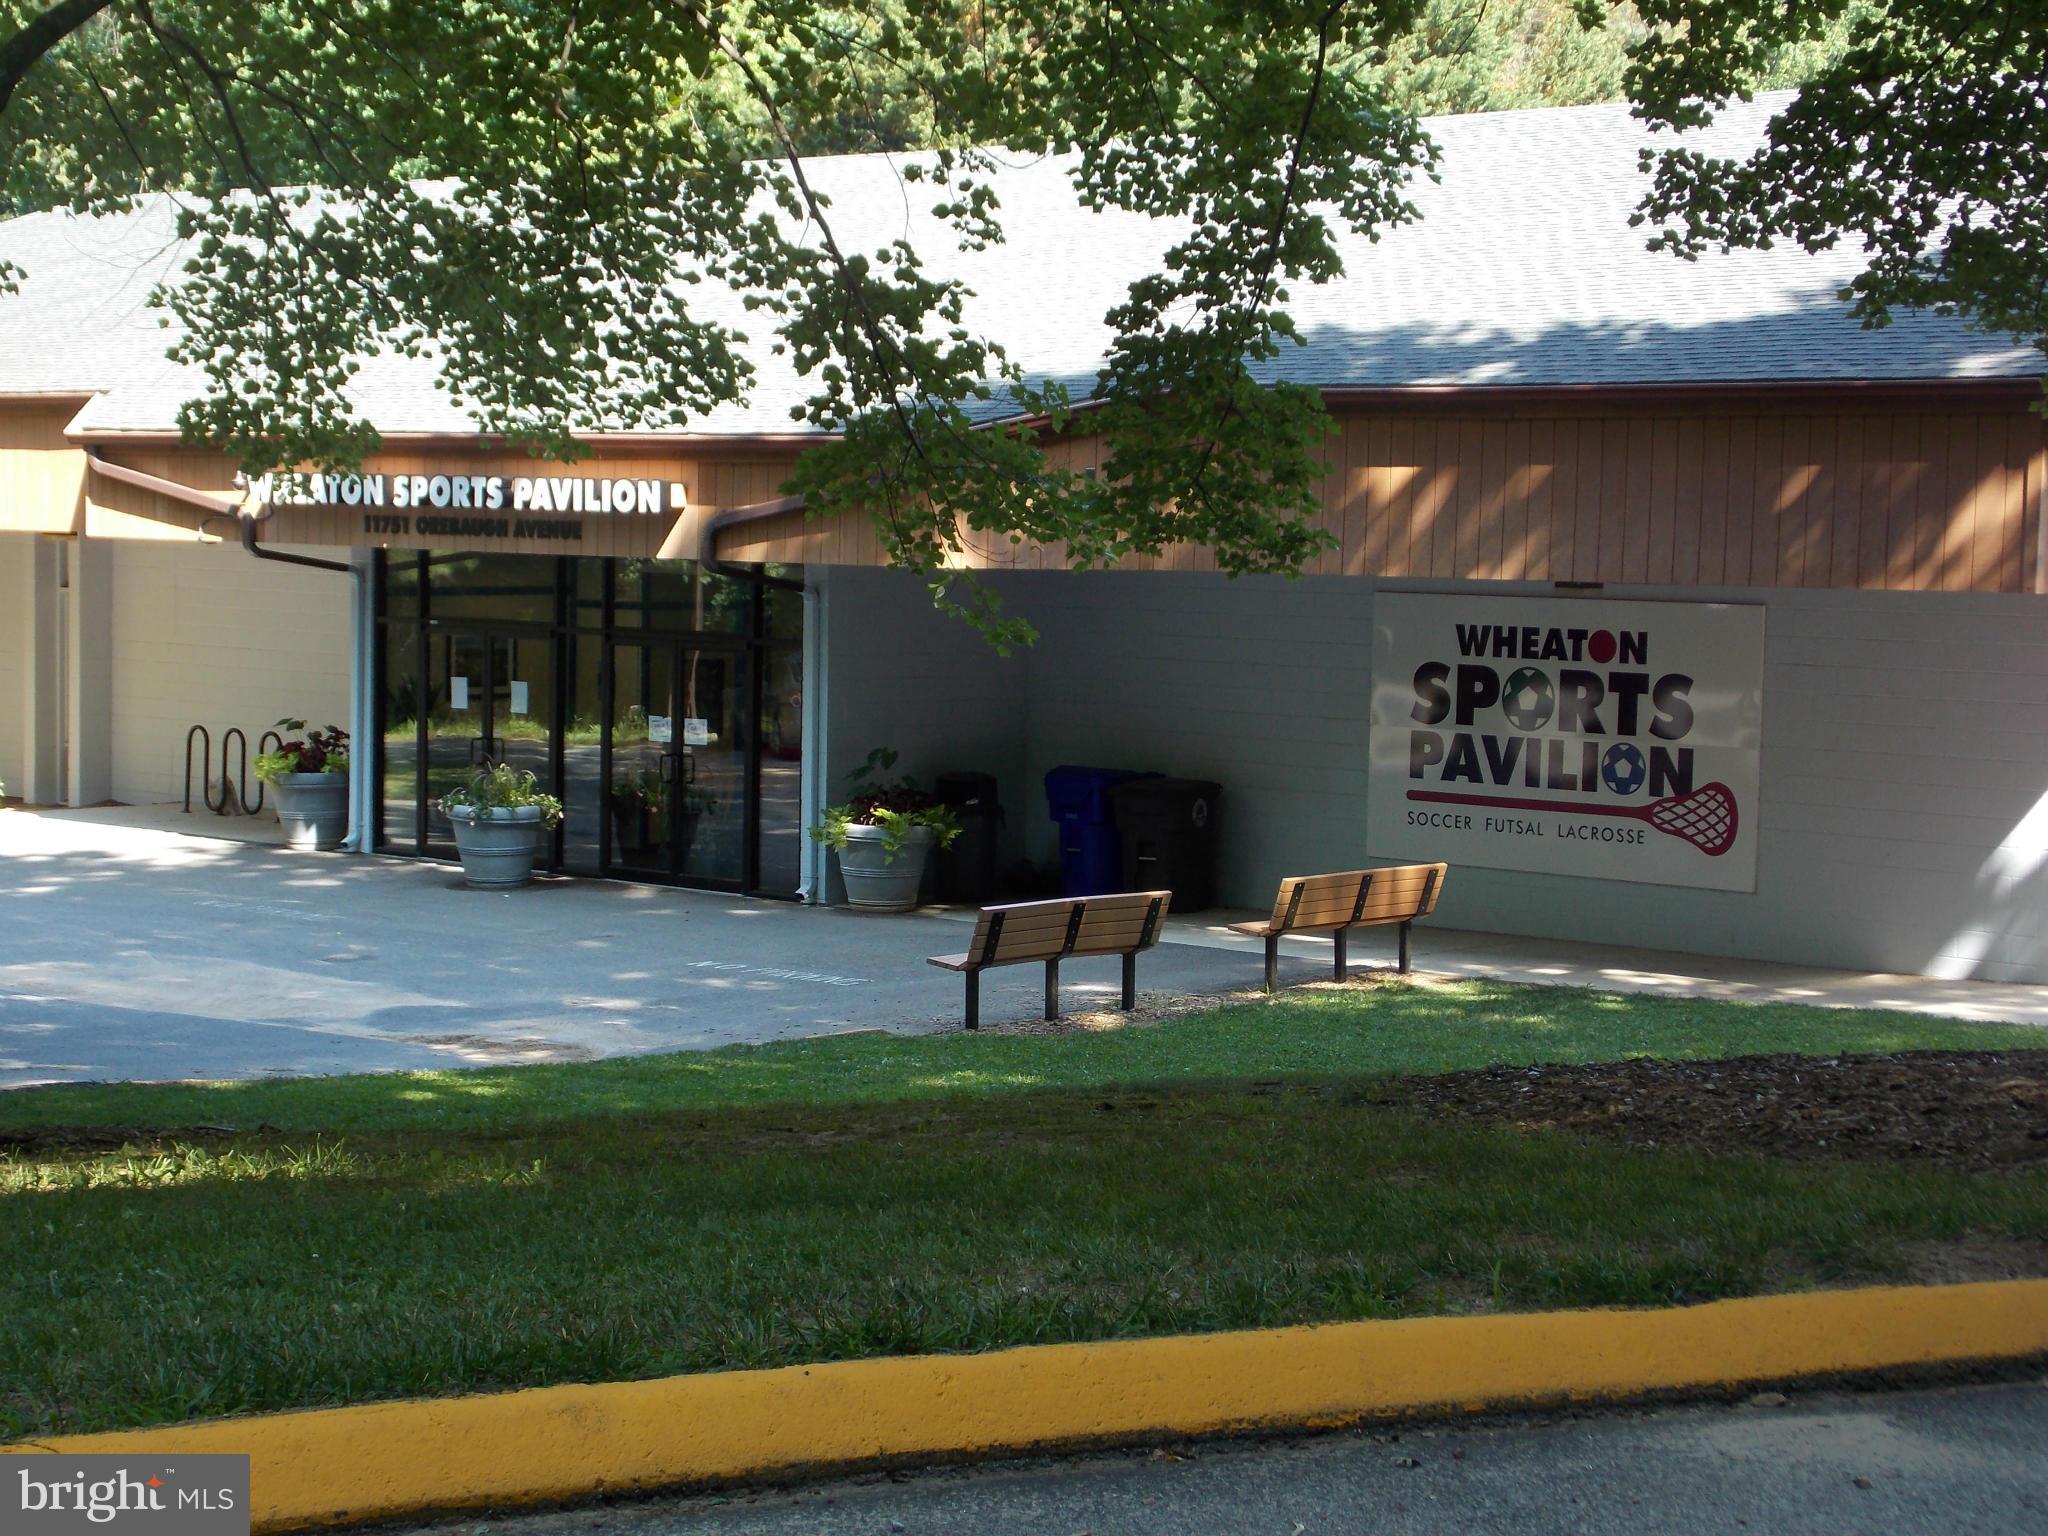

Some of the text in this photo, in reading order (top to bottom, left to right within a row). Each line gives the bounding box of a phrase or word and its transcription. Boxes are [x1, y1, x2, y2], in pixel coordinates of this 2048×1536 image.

[393, 475, 503, 510] SPORTS
[512, 477, 662, 513] PAVILION
[364, 515, 410, 534] 11751
[513, 519, 583, 541] AVENUE
[1455, 624, 1648, 665] WHEATON
[1410, 661, 1694, 740] SPORTS
[1409, 729, 1694, 798] PAVILION
[1407, 810, 1646, 845] SOCCER FUTSAL LACROSSE
